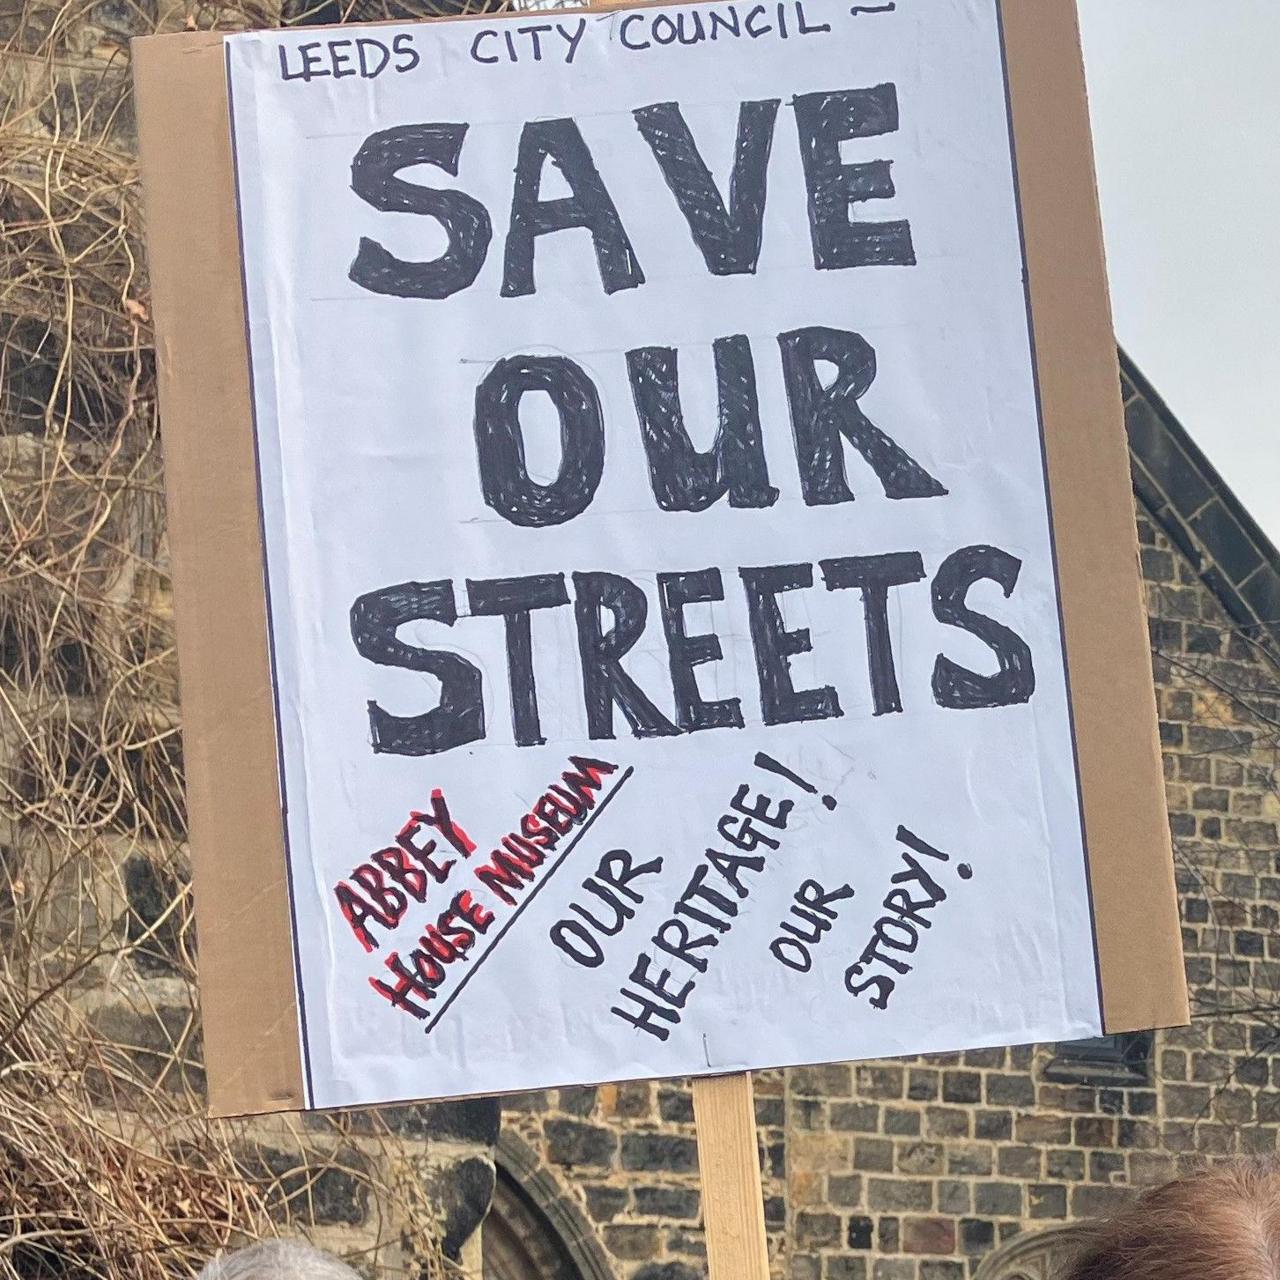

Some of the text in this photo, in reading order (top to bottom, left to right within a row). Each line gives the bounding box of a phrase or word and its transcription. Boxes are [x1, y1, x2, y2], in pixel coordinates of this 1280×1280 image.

[280, 2, 831, 82] LEEDS CITY COUNCIL
[348, 83, 917, 300] SAVE
[473, 326, 949, 528] OUR
[350, 545, 1035, 756] STREETS
[334, 788, 477, 953] ABBEY
[369, 755, 619, 1020] HOUSE MUSEUM
[549, 849, 663, 968] OUR
[610, 752, 838, 1042] HERITAGE!
[770, 878, 855, 973] OUR
[845, 824, 973, 1010] STORY!
